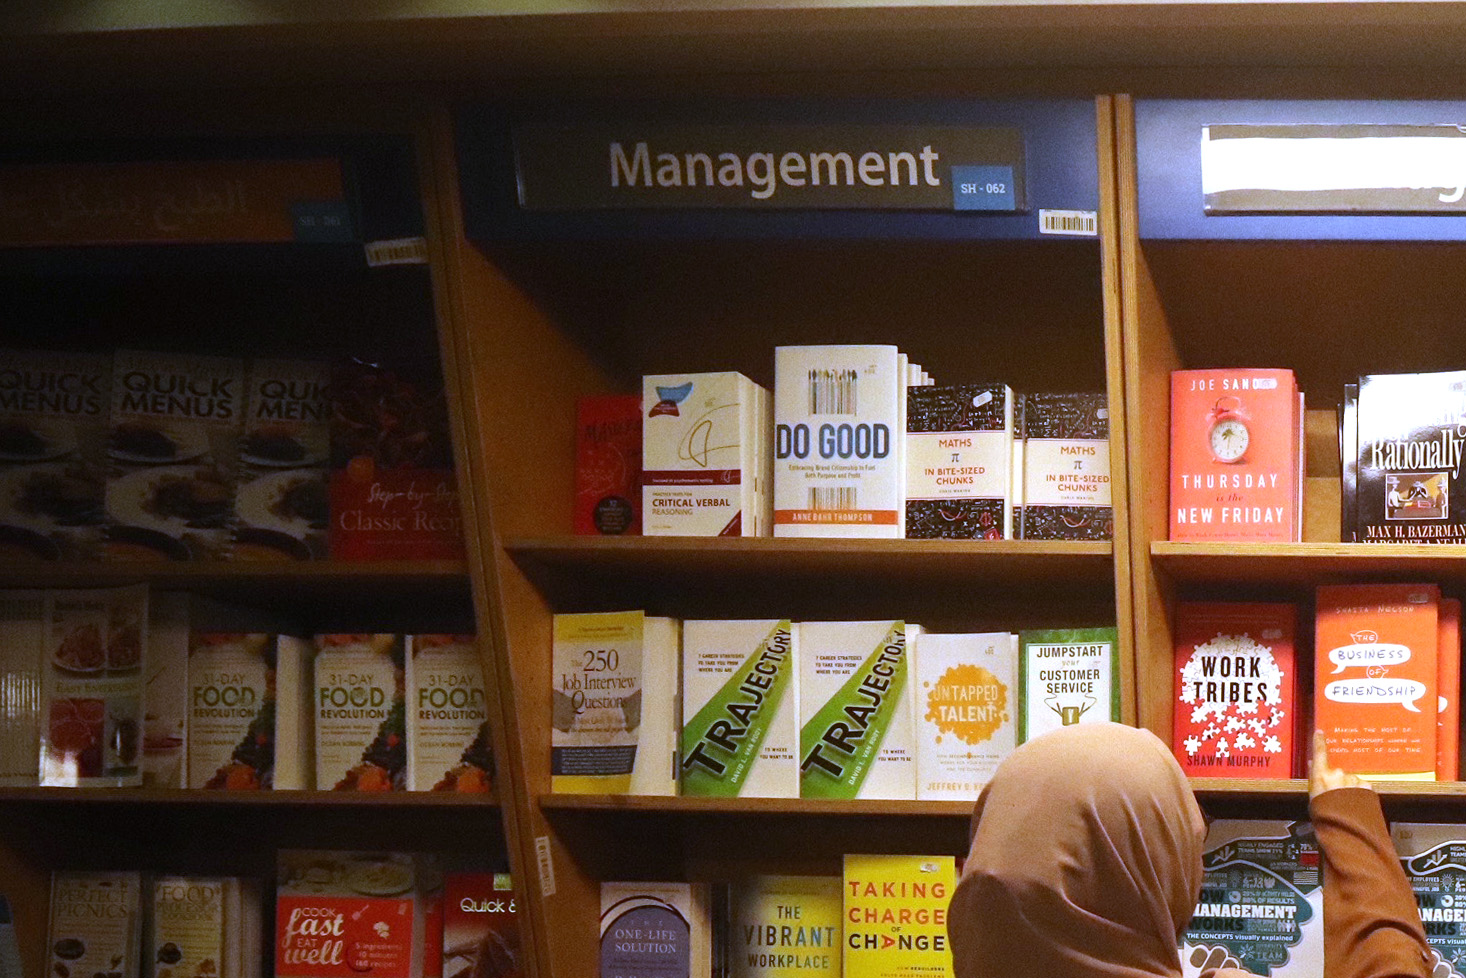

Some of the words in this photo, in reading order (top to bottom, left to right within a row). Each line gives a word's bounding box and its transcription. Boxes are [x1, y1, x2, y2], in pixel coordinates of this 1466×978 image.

[609, 142, 940, 199] Management
[961, 183, 977, 194] SH
[986, 183, 1006, 194] 062
[122, 371, 233, 399] QUICK
[1191, 380, 1215, 391] JOE
[120, 393, 232, 419] MENUS
[776, 423, 810, 460] DO
[819, 423, 890, 460] GOOD
[938, 439, 972, 448] MATHS
[1371, 428, 1465, 480] Rationally
[937, 467, 985, 475] BITE-SIZED
[936, 476, 973, 485] CHUNKS
[1182, 474, 1278, 488] THURSDAY
[652, 499, 694, 507] CRITICAL
[1178, 508, 1212, 523] NEW
[1222, 507, 1284, 523] FRIDAY
[1036, 646, 1103, 658] JUMPSTART
[1338, 650, 1403, 660] BUSINESS
[583, 650, 619, 672] 250
[1201, 656, 1260, 678] WORK
[562, 674, 583, 689] Job
[584, 672, 636, 689] Interview
[1040, 669, 1100, 681] CUSTOMER
[934, 684, 998, 700] UNTAPPED
[1046, 682, 1093, 694] SERVICE
[1194, 682, 1268, 703] TRIBES
[1333, 686, 1415, 696] FRIENDSHIP
[320, 687, 385, 708] FOOD
[683, 629, 791, 775] TRAJECTORY
[801, 630, 906, 778] TRAJECTORY
[320, 709, 385, 720] REVOLUTION
[939, 705, 994, 722] TALENT
[1187, 755, 1222, 766] SHAWN
[1227, 756, 1270, 767] MURPHY
[849, 882, 946, 898] TAKING
[302, 907, 335, 917] COOK
[460, 898, 505, 913] Quick
[849, 908, 945, 924] CHARGE
[282, 908, 344, 948] fast
[615, 929, 677, 941] ONE-LIFE
[745, 925, 835, 947] VIBRANT
[297, 938, 317, 947] EAT
[615, 942, 676, 953] SOLUTION
[849, 934, 945, 950] CHANGE
[284, 940, 344, 965] well
[748, 954, 829, 969] WORKPLACE
